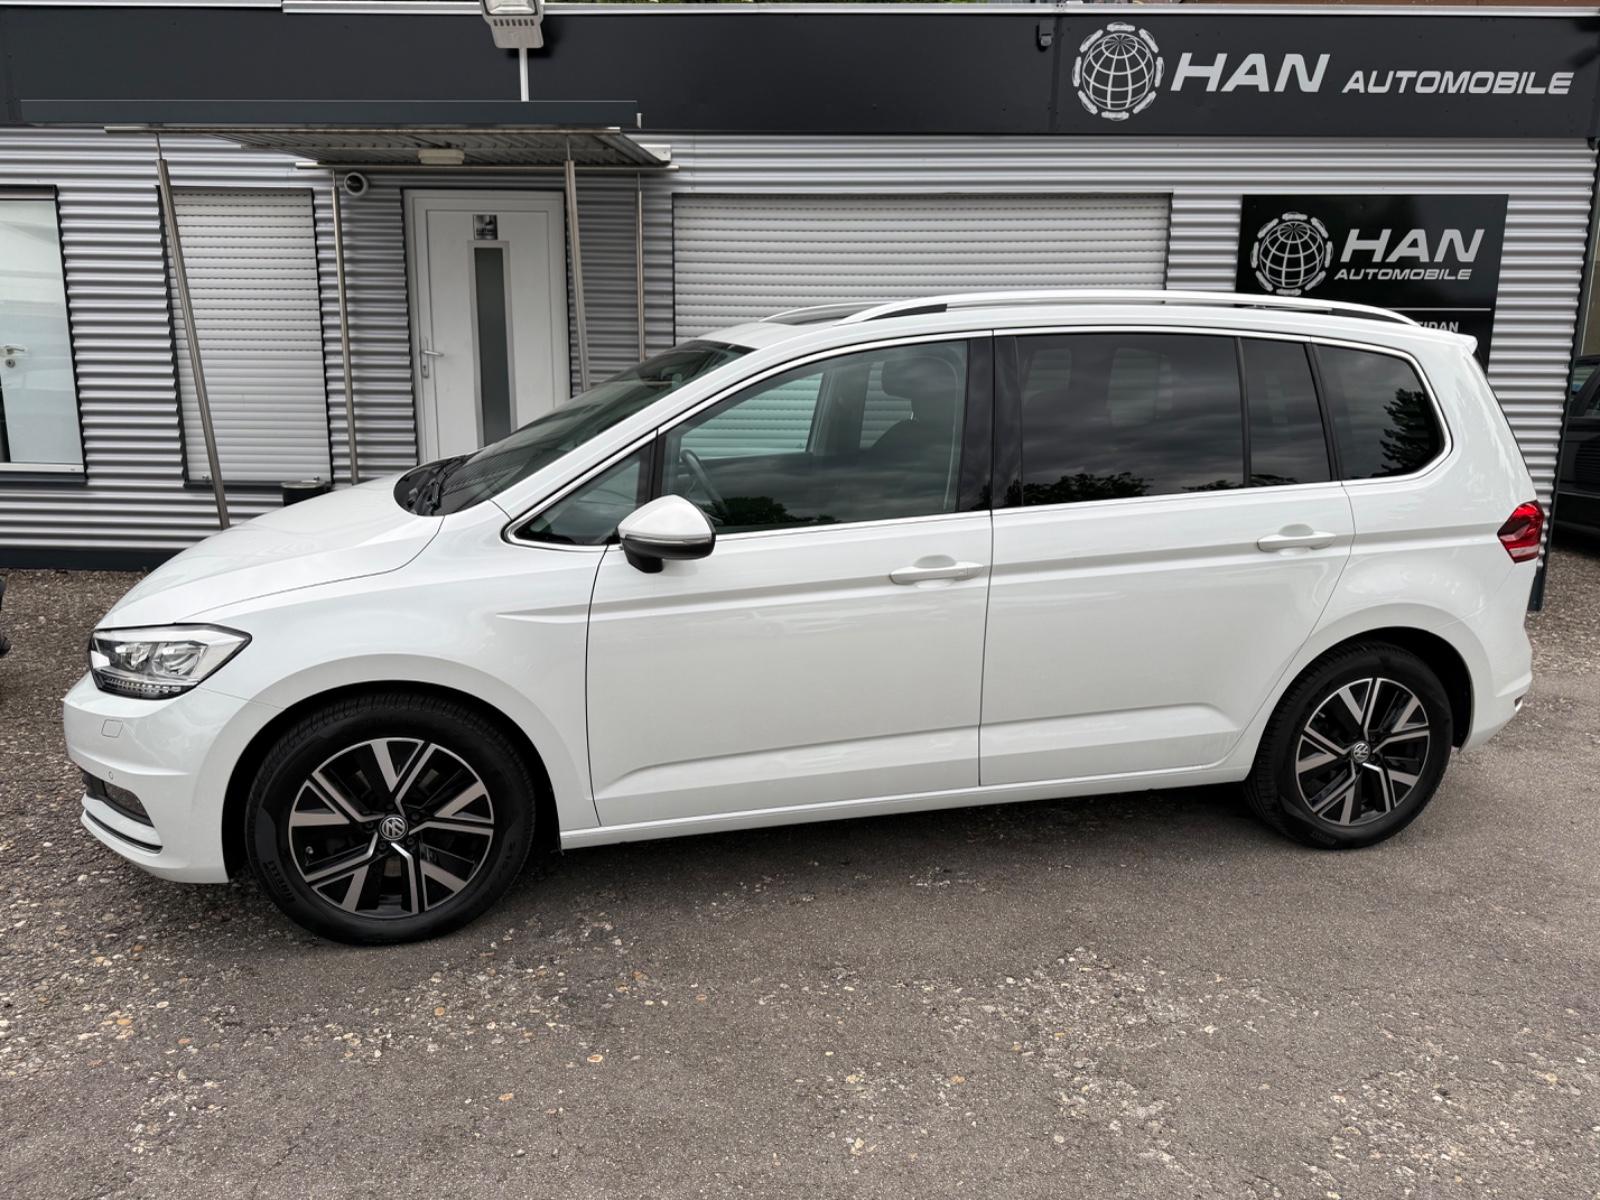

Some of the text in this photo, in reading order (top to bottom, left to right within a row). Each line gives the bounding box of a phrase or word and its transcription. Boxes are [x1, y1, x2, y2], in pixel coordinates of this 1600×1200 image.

[1170, 52, 1575, 95] HAN AUTOMOBILE
[1340, 228, 1486, 263] HAN
[1334, 268, 1473, 281] AUTOMOBILE
